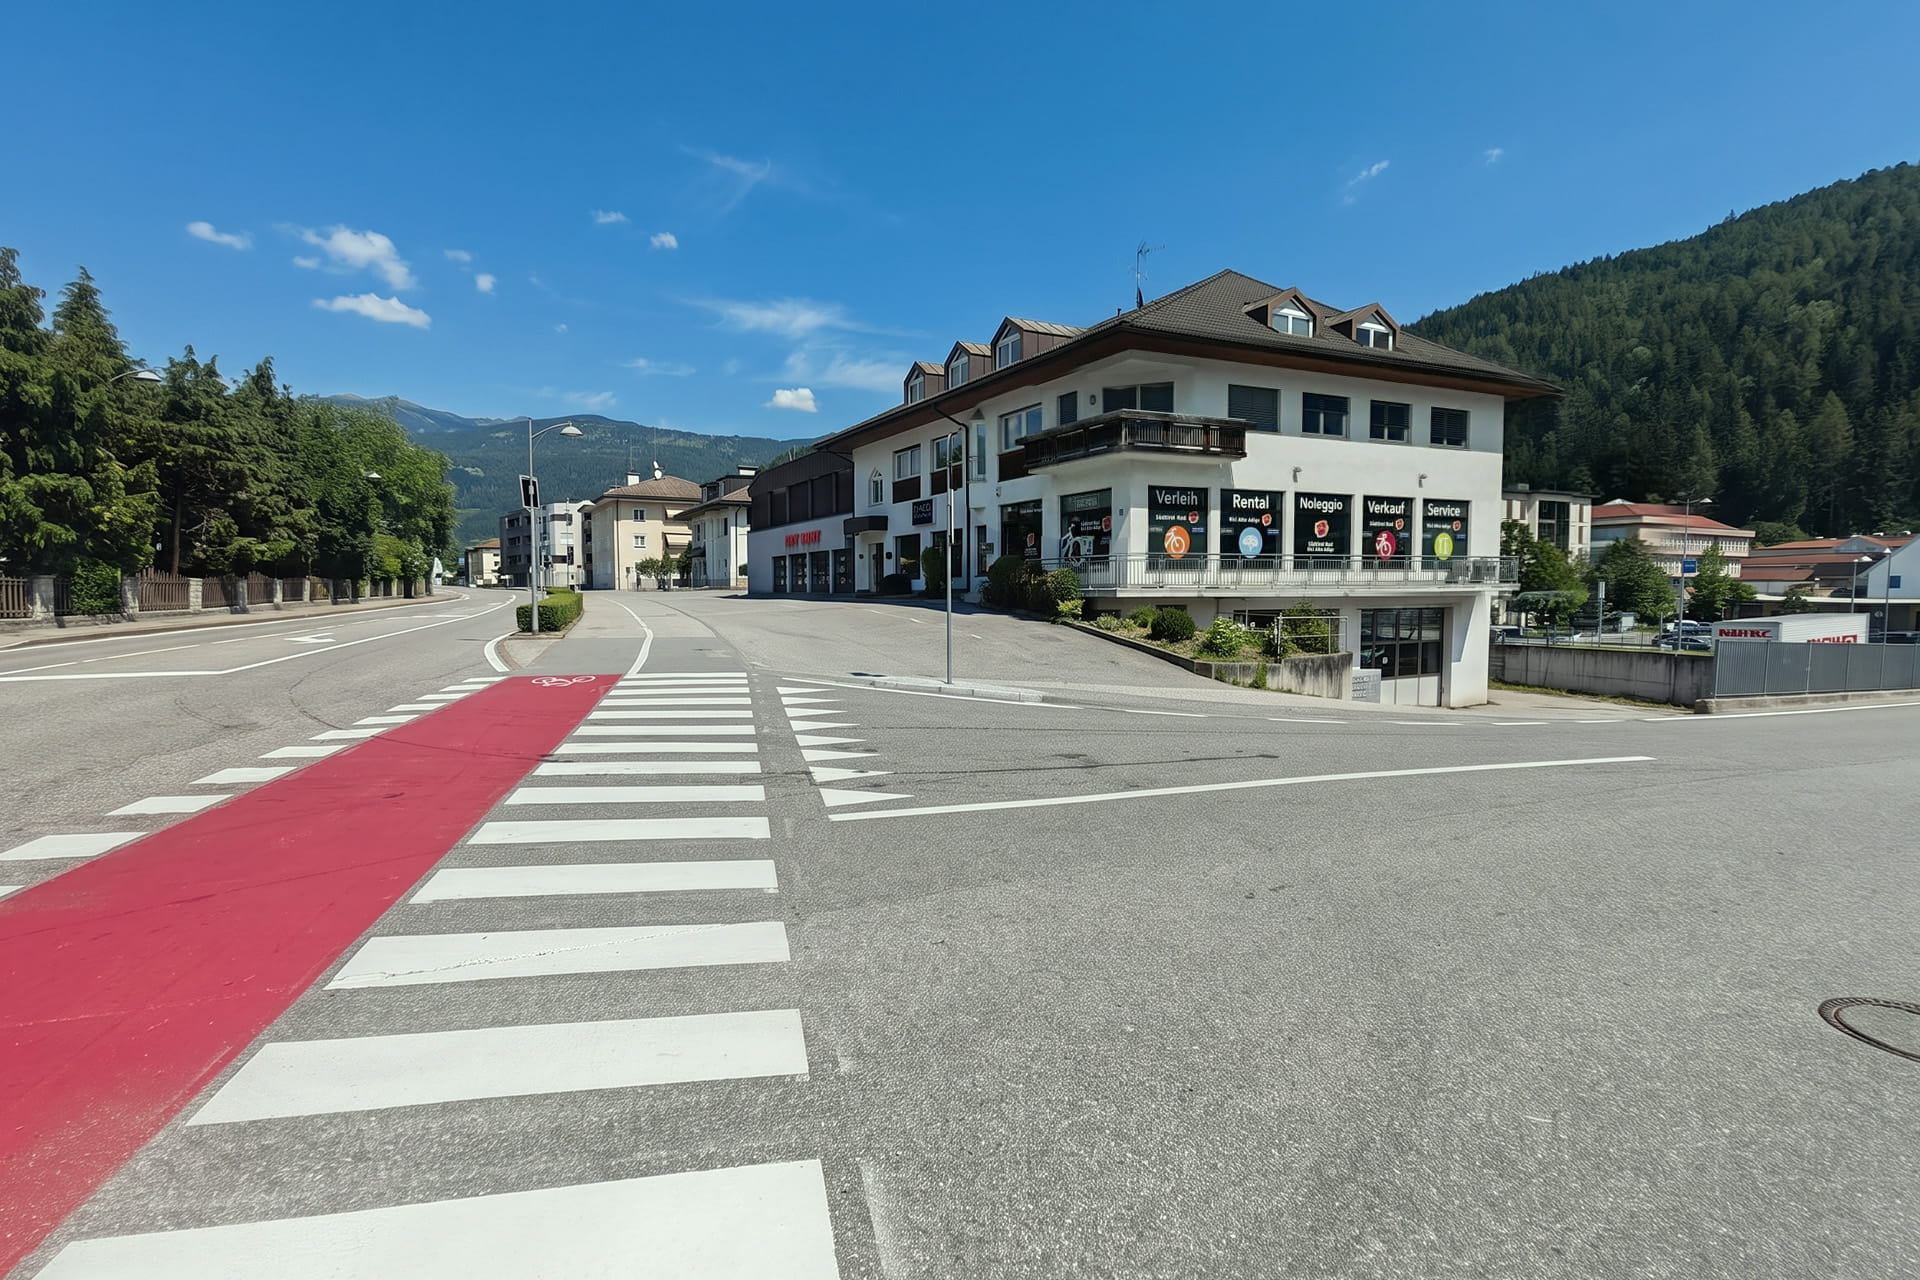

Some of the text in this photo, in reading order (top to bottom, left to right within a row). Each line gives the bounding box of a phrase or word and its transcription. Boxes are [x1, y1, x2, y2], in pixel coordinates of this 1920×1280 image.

[1156, 489, 1198, 506] Verleih
[1232, 493, 1269, 509] Rental
[1300, 497, 1343, 513] Noleggio
[1368, 500, 1405, 515] Verkauf
[1428, 503, 1461, 517] Service
